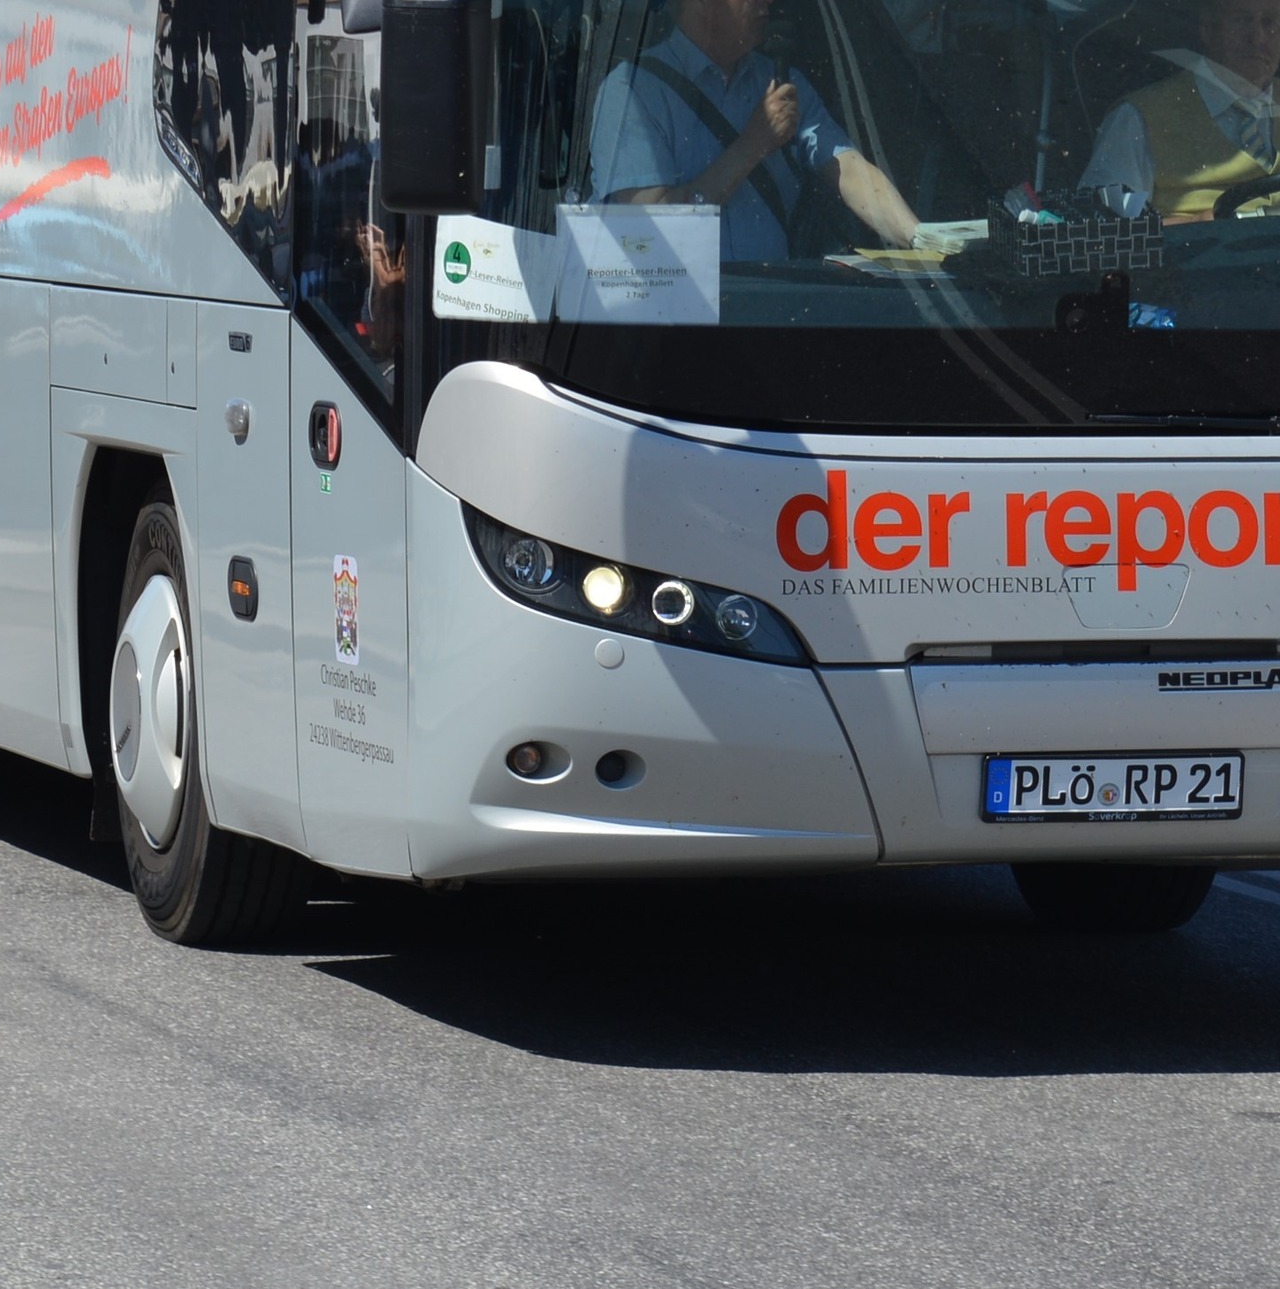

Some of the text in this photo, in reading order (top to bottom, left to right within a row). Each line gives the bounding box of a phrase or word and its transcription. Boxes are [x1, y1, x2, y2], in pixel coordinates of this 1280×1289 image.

[5, 21, 27, 85] auf
[30, 12, 55, 69] den
[452, 243, 461, 263] 4
[587, 265, 687, 278] Reporter-Leser-Reisen
[601, 279, 674, 289] Kopenhagen Ballett
[436, 289, 530, 324] Kopenhagen Shopping
[633, 291, 650, 300] Tage
[776, 470, 970, 572] der
[782, 576, 1097, 595] DAS FAMILIENWOCHENBLATT
[321, 664, 377, 697] Christian Peschke
[333, 698, 366, 725] Wehde 36
[310, 723, 329, 747] 24238
[1015, 763, 1236, 806] PLÖ RP 21
[993, 791, 1003, 803] D
[995, 815, 1045, 823] Mercedes-Benz
